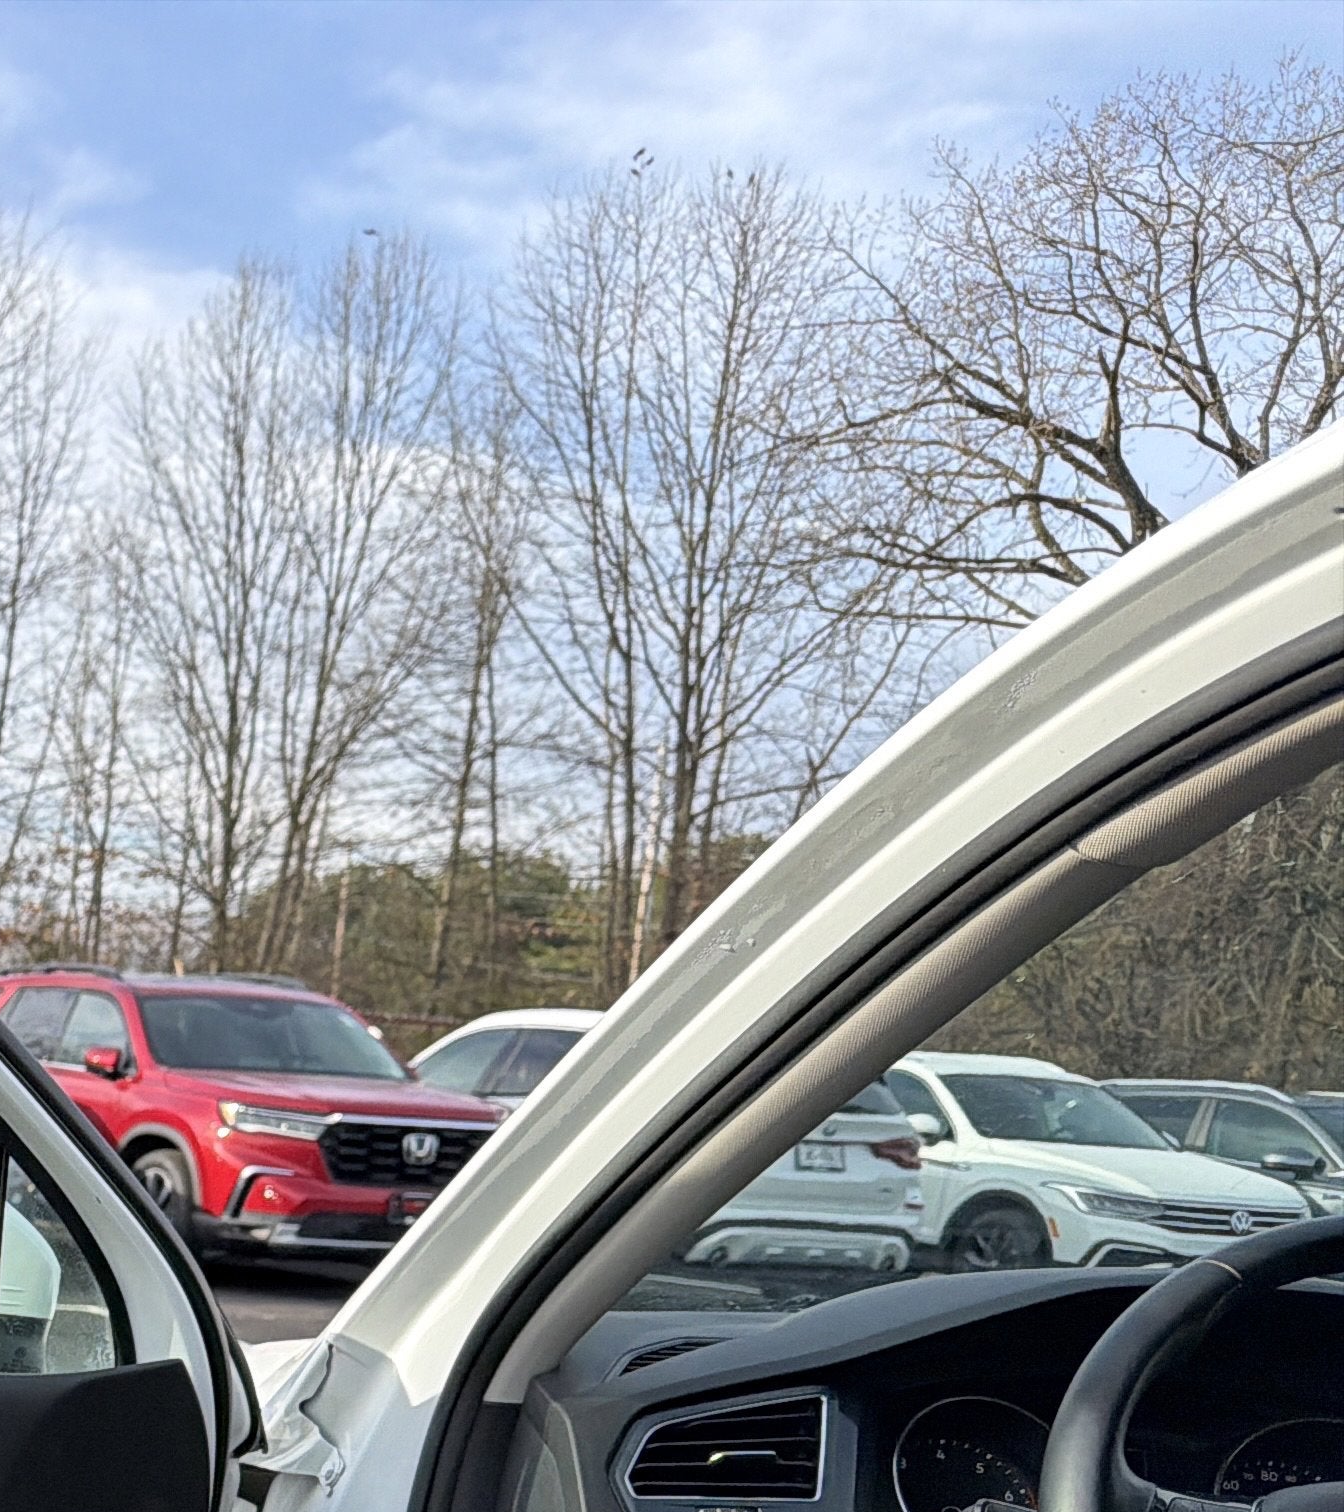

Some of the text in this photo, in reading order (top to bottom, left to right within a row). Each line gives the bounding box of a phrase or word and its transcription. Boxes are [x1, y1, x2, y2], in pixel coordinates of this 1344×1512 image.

[975, 1462, 985, 1475] 5
[1260, 1470, 1279, 1482] 80
[1222, 1480, 1240, 1491] 60
[1004, 1490, 1014, 1502] 6
